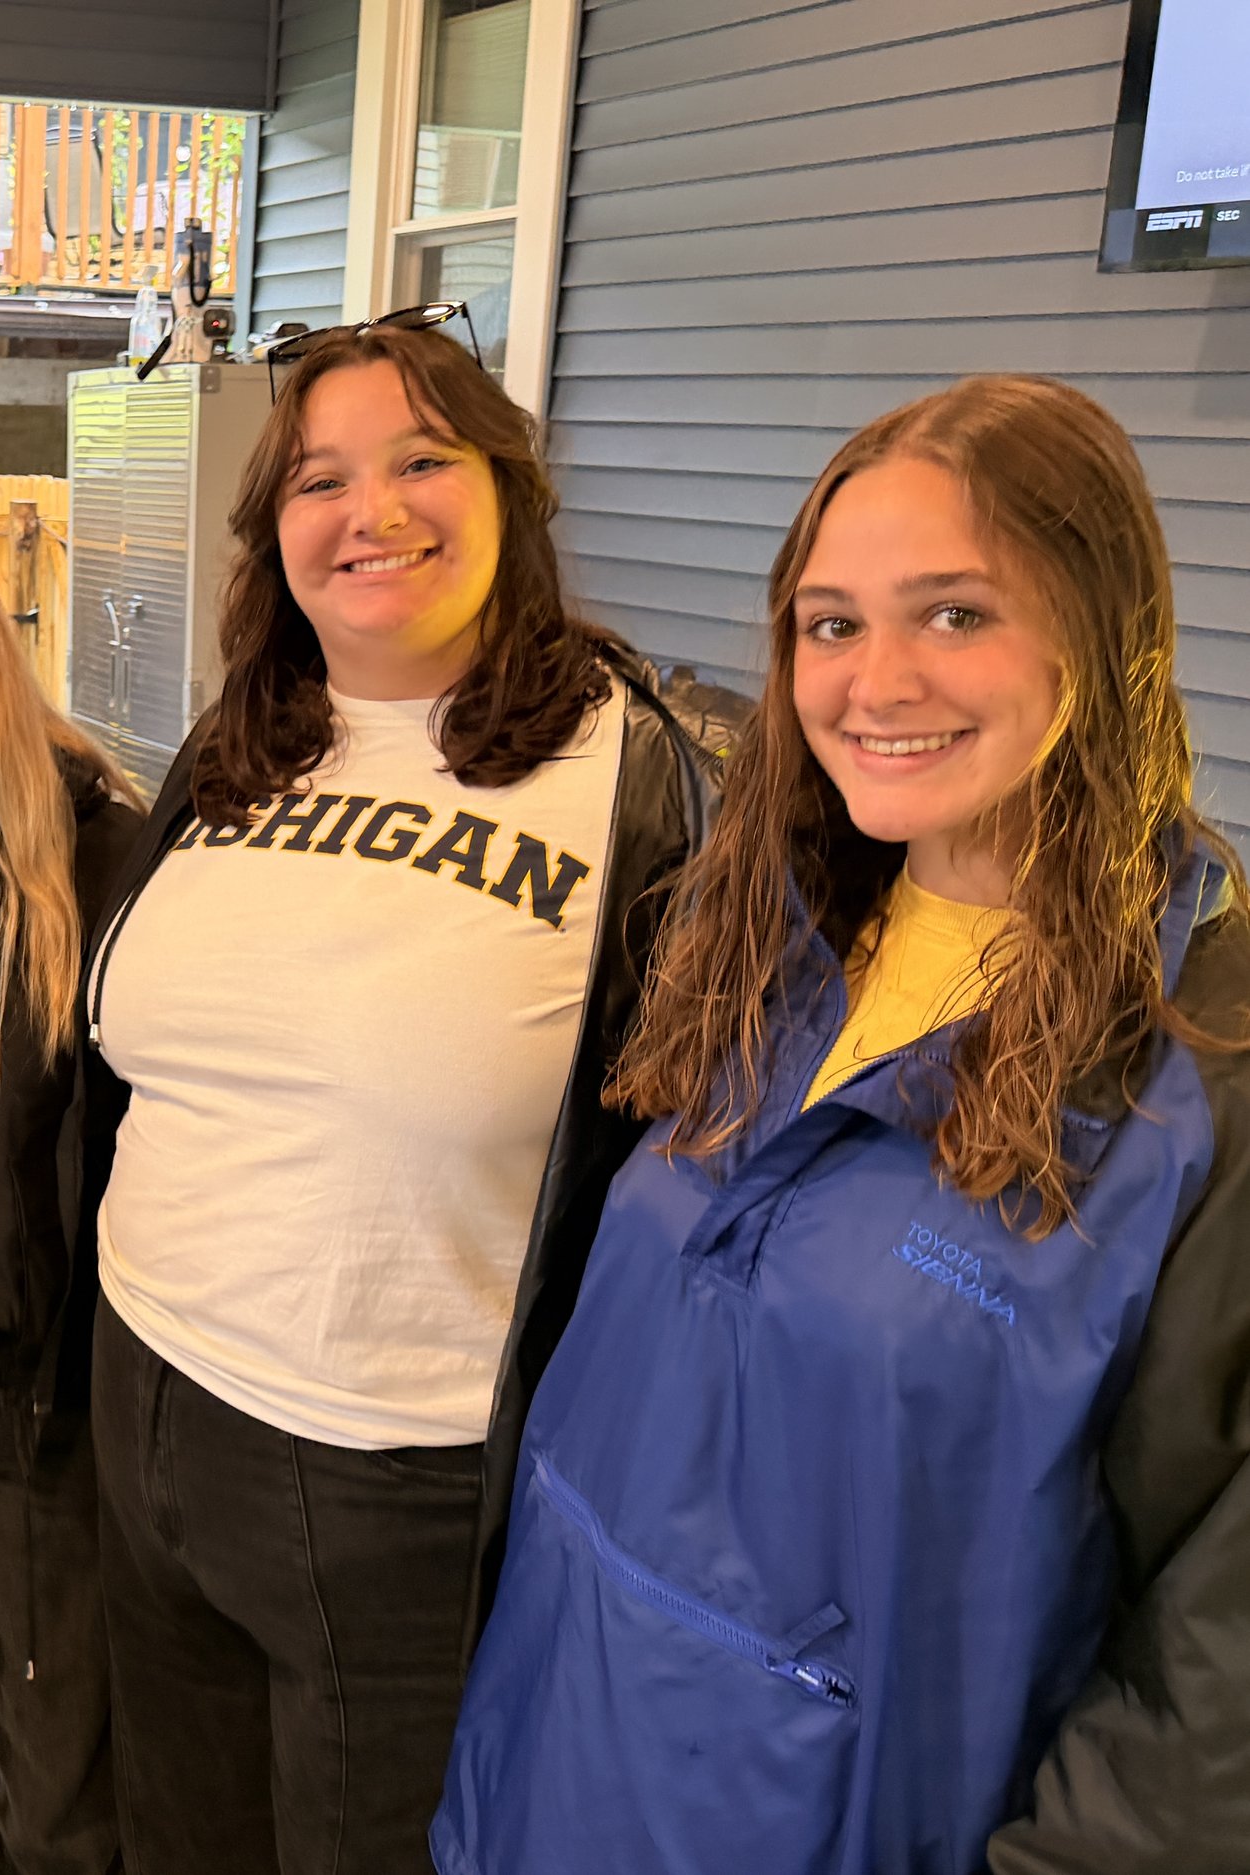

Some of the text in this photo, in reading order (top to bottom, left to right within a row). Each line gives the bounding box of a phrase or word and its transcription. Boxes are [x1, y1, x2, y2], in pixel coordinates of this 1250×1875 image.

[1176, 170, 1193, 183] Do
[1194, 168, 1213, 182] not
[1215, 165, 1239, 179] take
[1146, 210, 1203, 232] ESPN
[1216, 209, 1240, 222] SEC
[907, 1220, 982, 1280] TOYOTA
